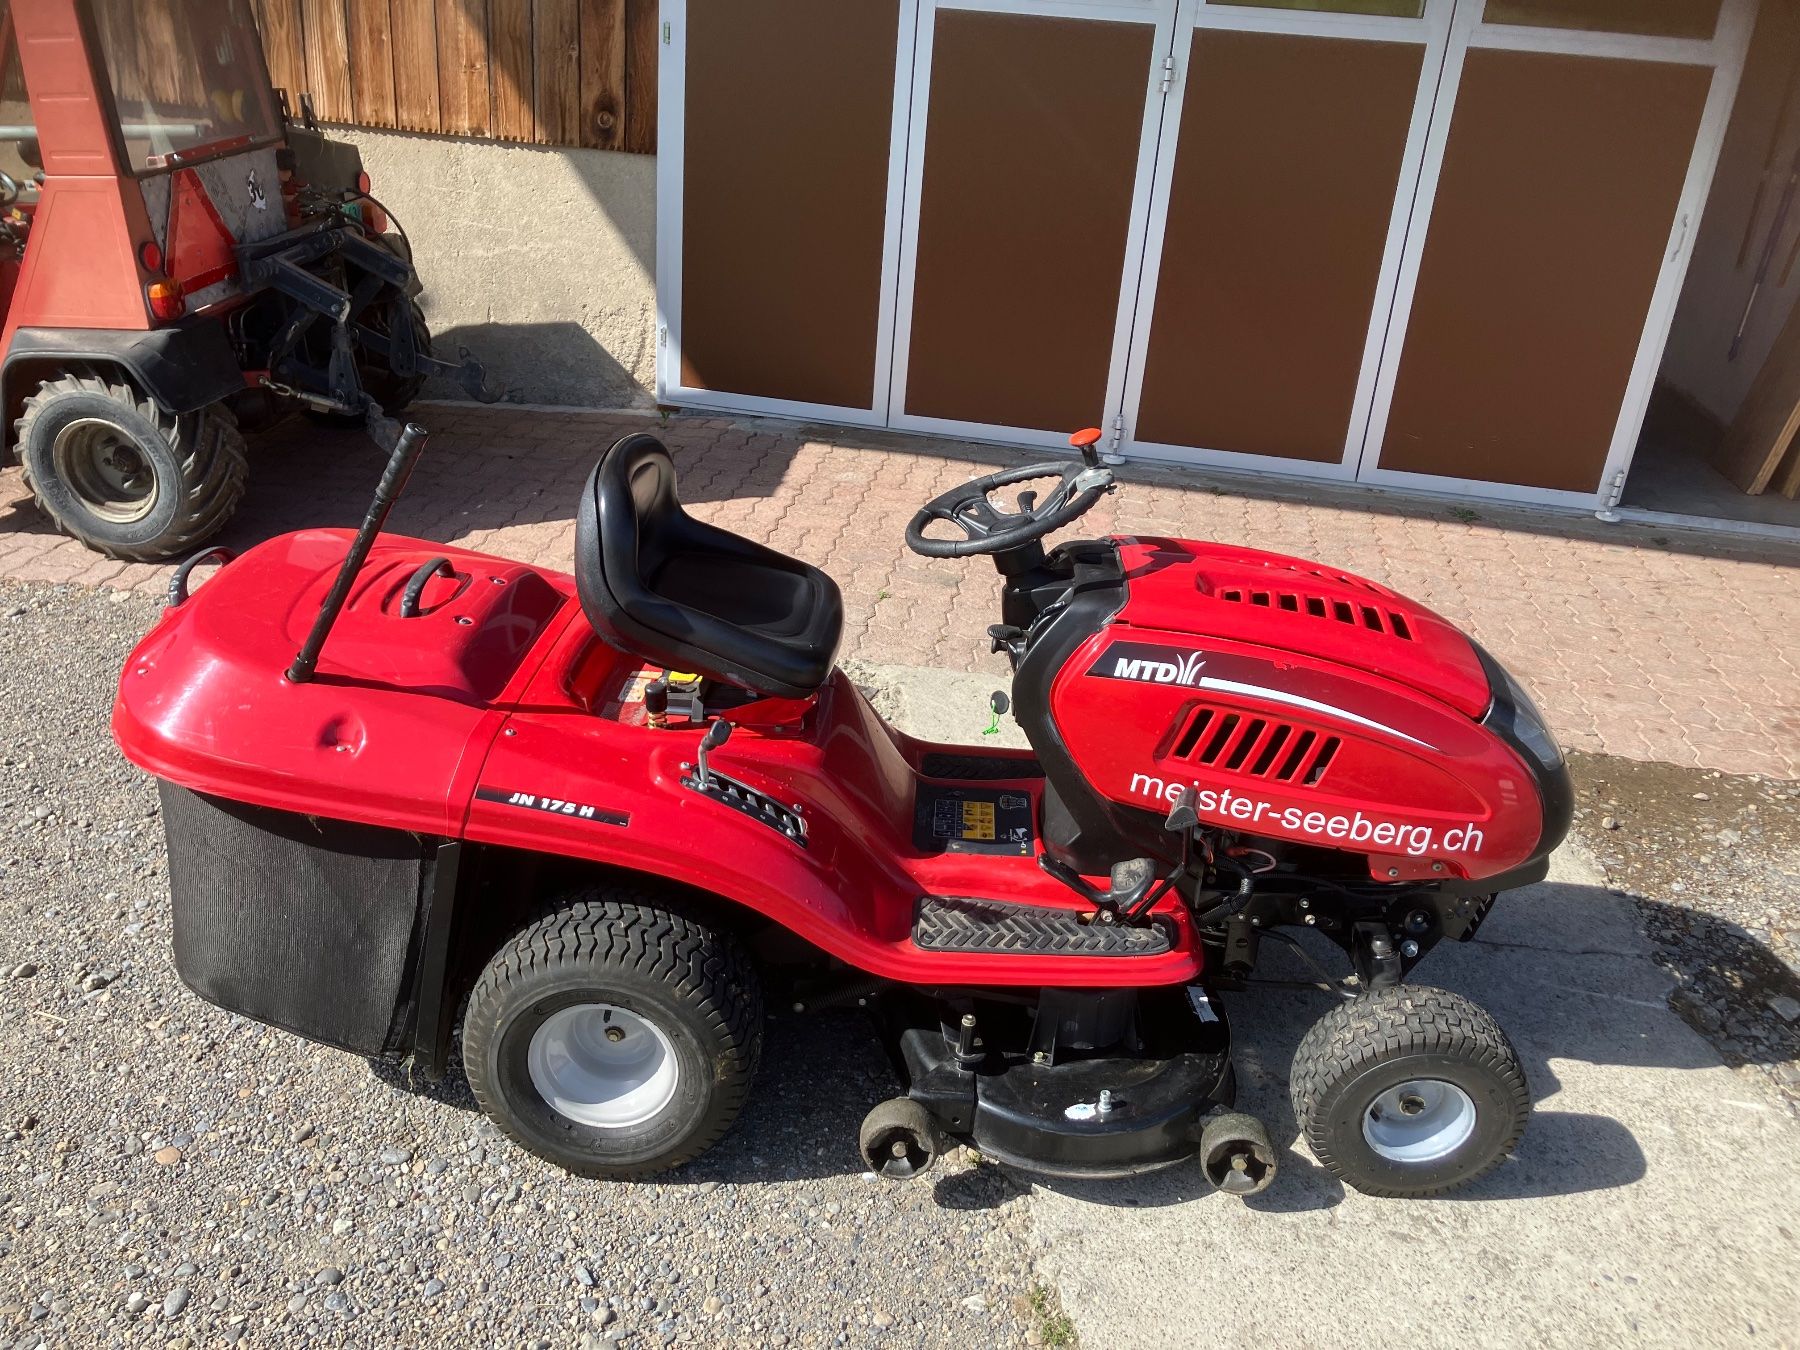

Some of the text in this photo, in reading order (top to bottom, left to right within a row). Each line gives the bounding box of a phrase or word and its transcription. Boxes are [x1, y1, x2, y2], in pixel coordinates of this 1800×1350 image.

[1113, 657, 1178, 683] MTD
[508, 792, 596, 818] JN 175 H
[1129, 772, 1484, 856] mester-seeberg.ch
